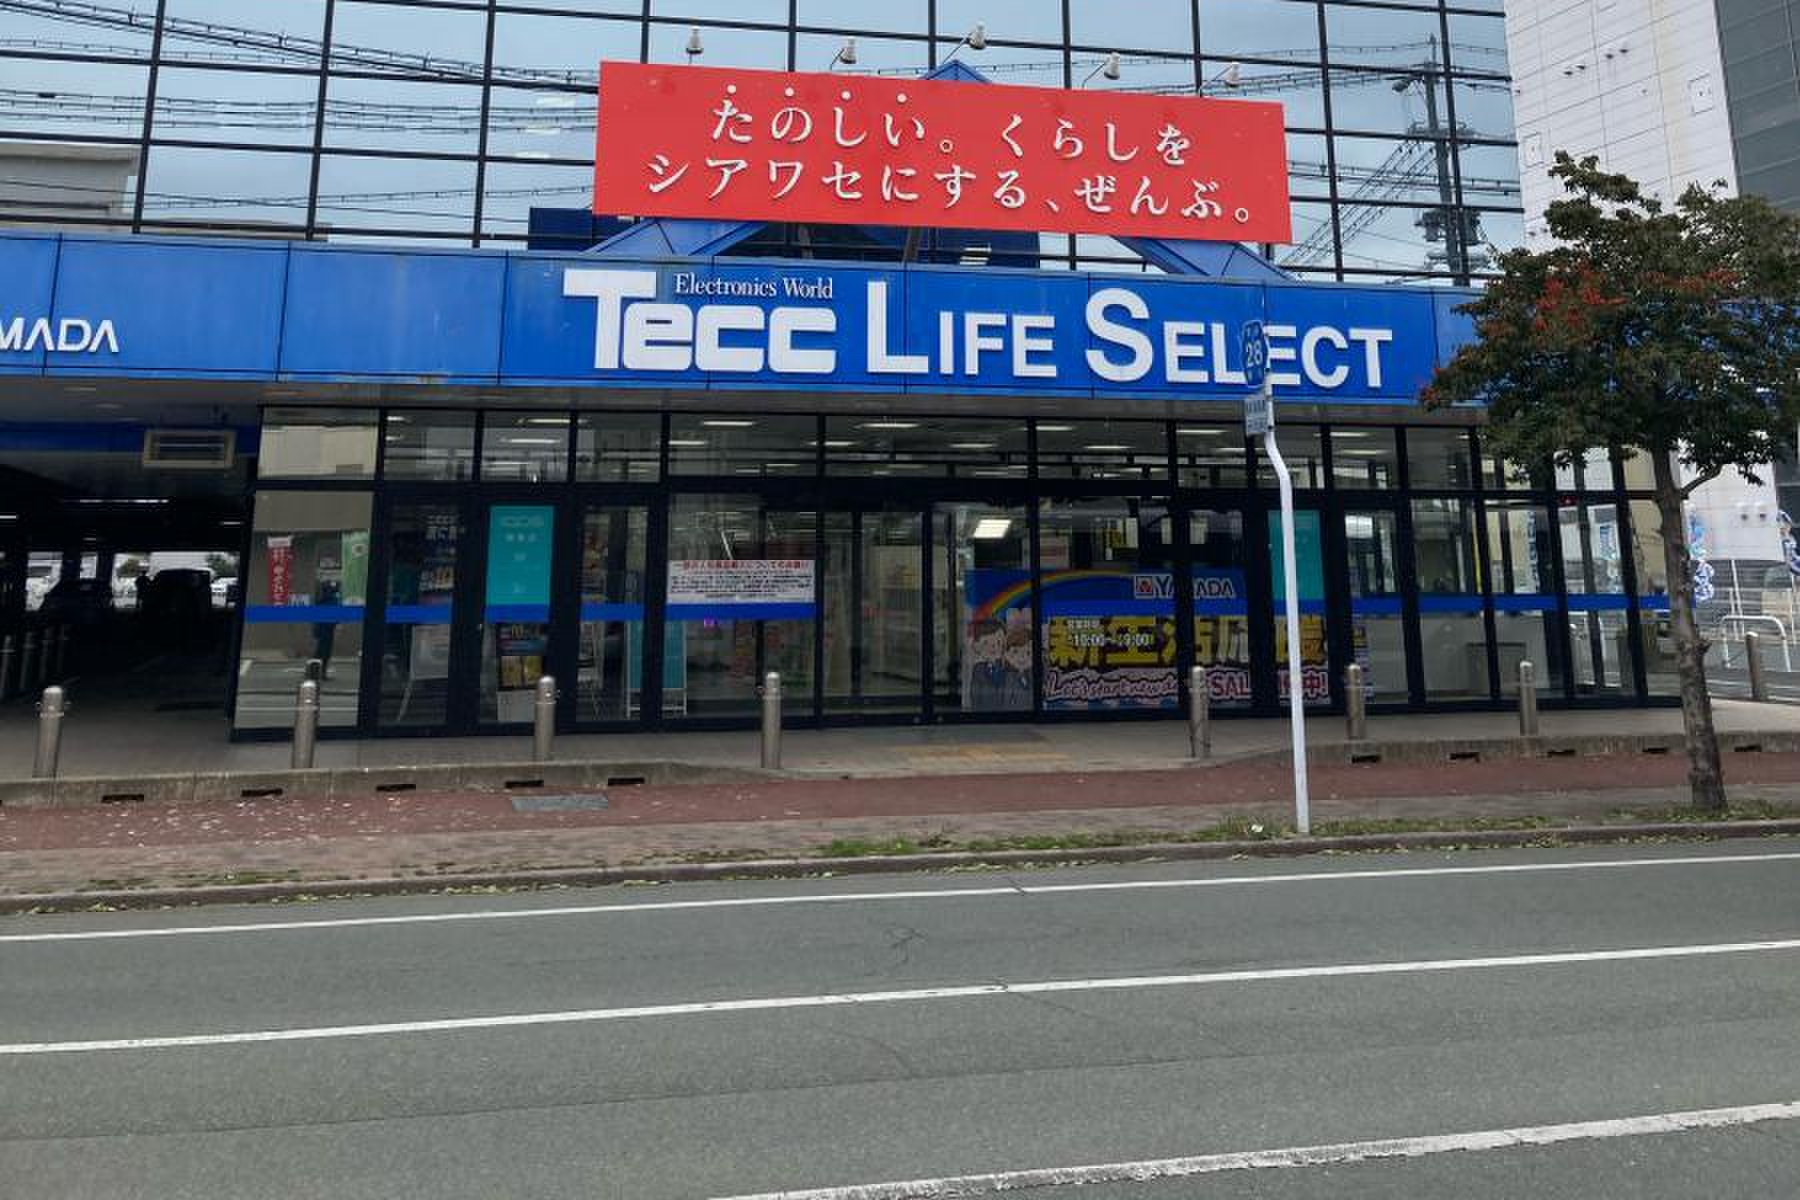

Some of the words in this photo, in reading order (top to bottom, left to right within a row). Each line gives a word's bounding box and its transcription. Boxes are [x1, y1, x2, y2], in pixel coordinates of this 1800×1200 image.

[646, 153, 1250, 224] シアワセにする、ぜんぶ。
[674, 272, 776, 297] Electronics
[782, 276, 834, 299] World
[563, 268, 837, 374] Tecc
[867, 281, 1057, 377] LIFE
[1085, 288, 1393, 389] SELECT
[1245, 339, 1263, 367] 28
